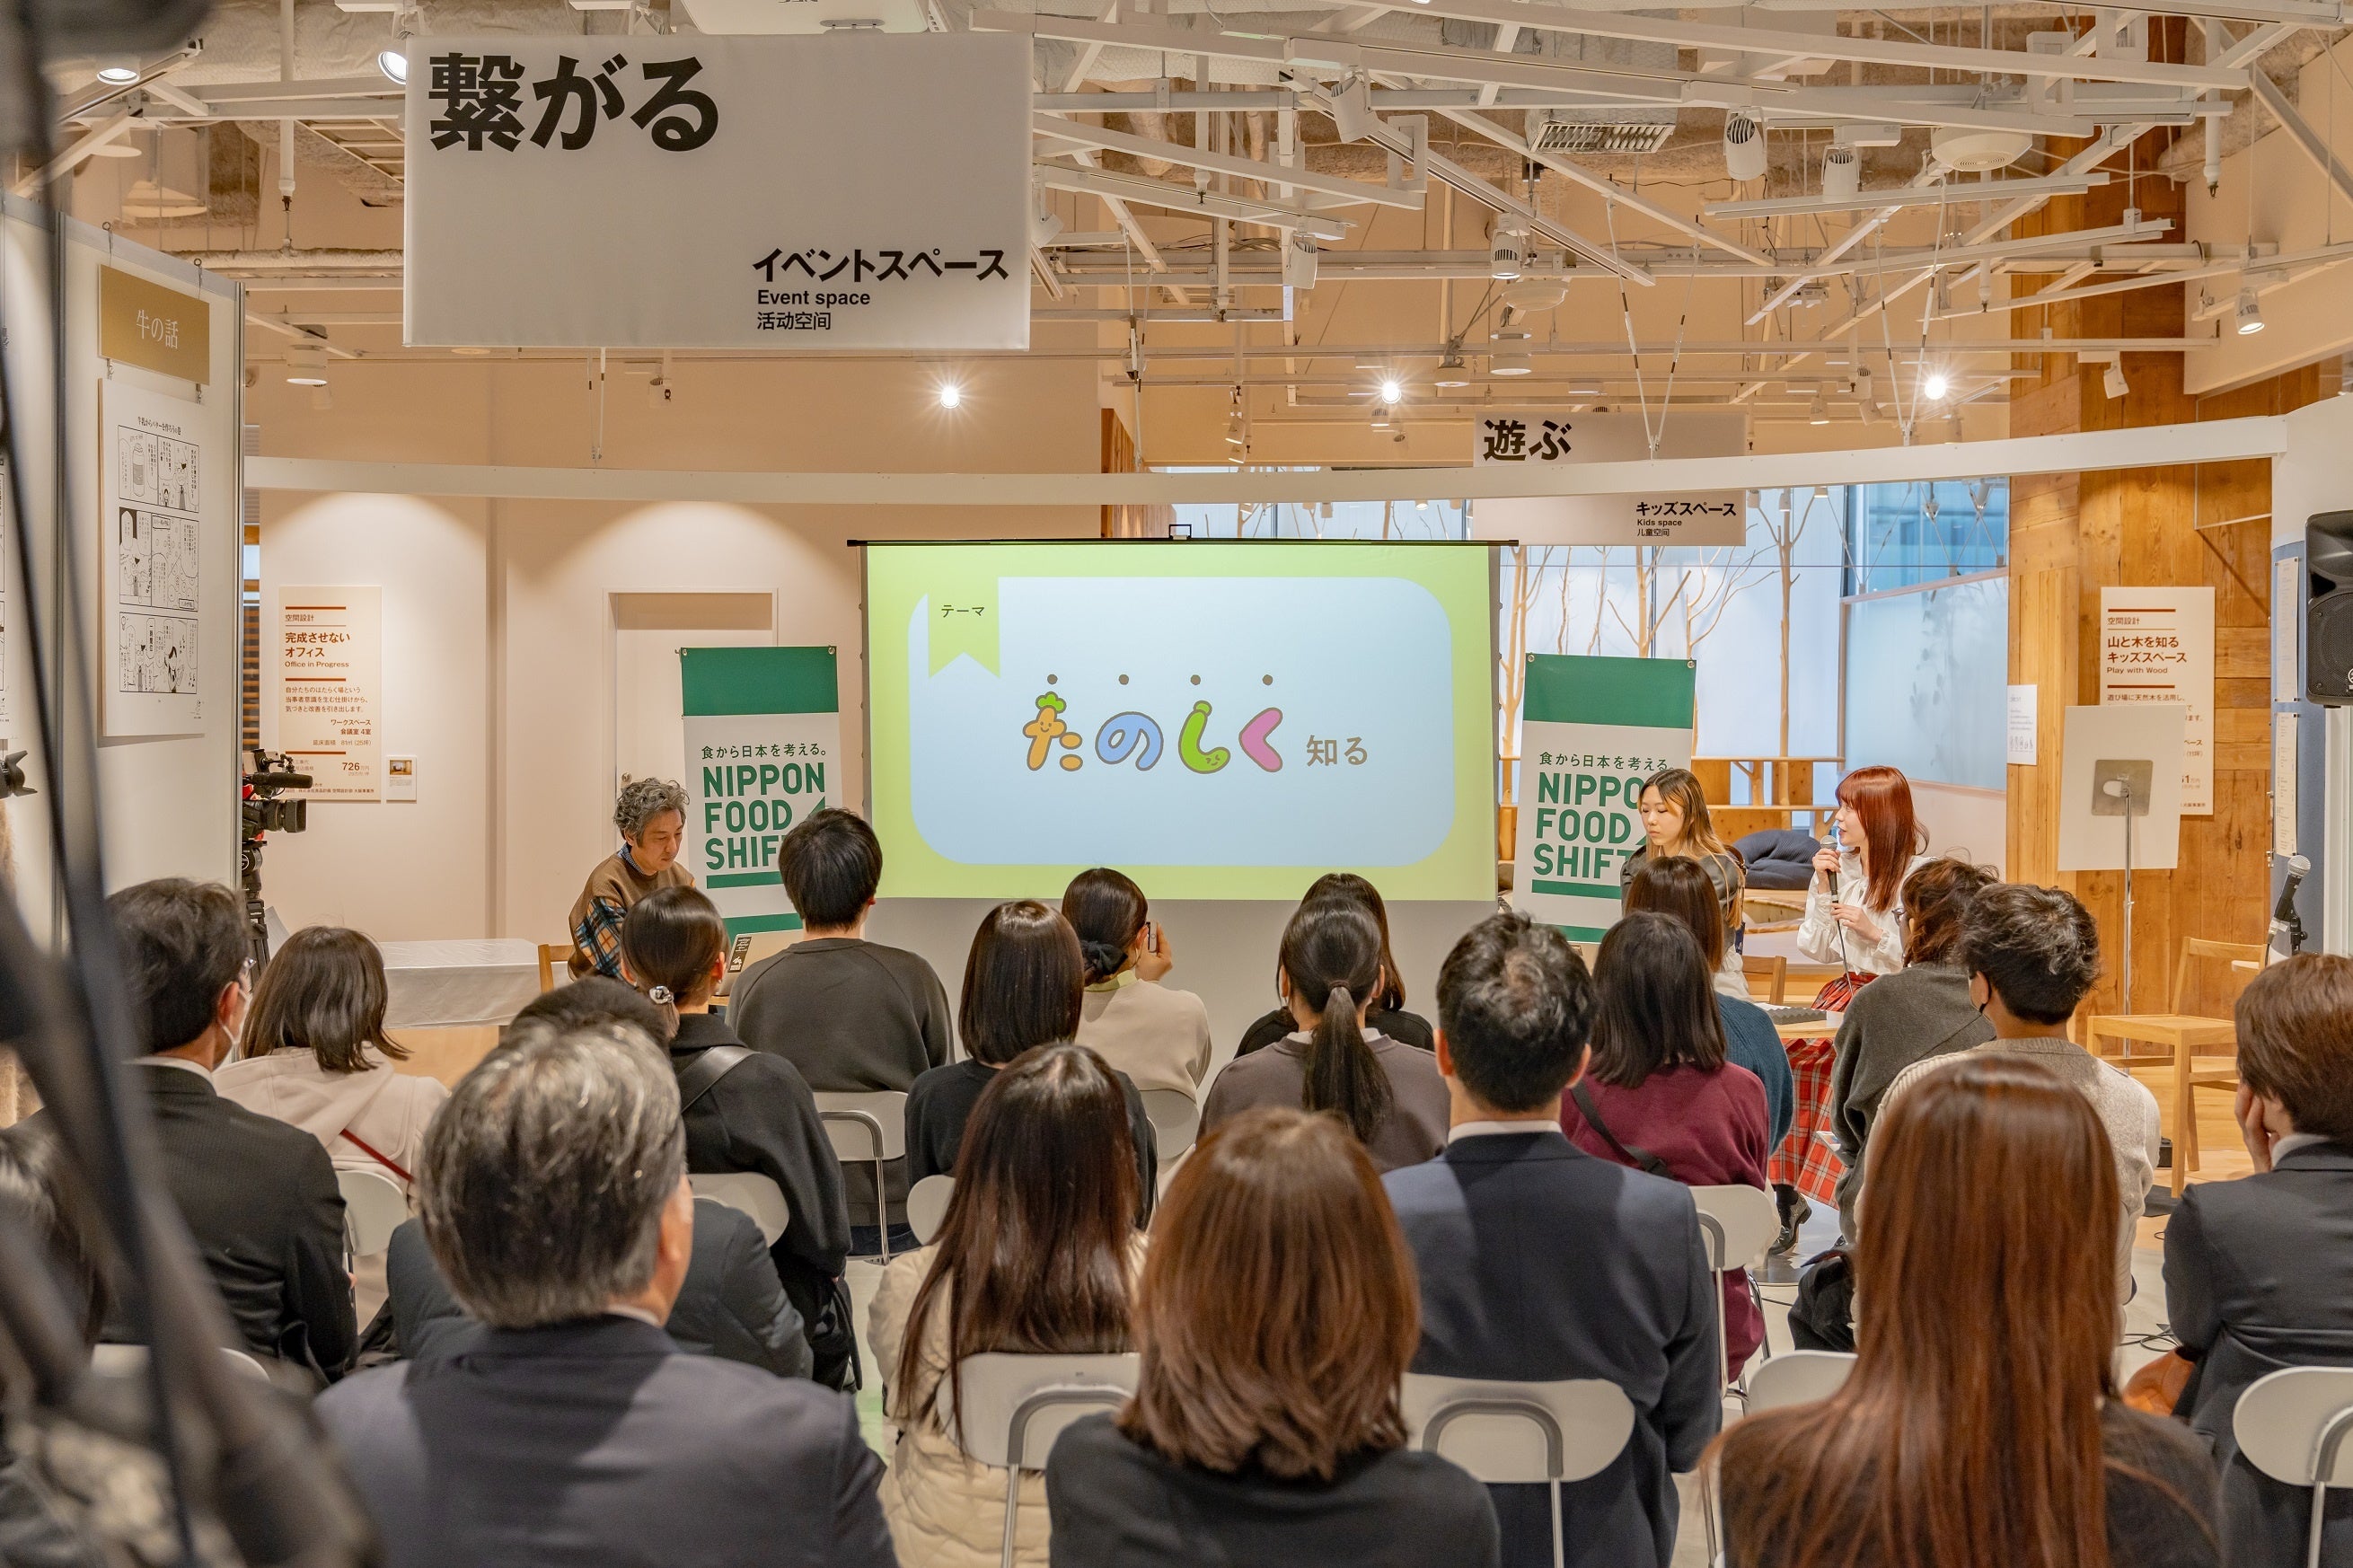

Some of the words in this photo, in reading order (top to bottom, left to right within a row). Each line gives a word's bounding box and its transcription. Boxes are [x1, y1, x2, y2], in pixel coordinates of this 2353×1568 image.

[428, 52, 719, 153] 繋がる
[752, 247, 1010, 283] イベントスペース
[757, 288, 809, 306] Event
[815, 291, 871, 311] space
[136, 308, 179, 350] 牛の話
[756, 311, 832, 331] 活动空间
[1483, 418, 1573, 462] 遊ぶ
[1635, 500, 1737, 517] キッズスペース
[1637, 518, 1656, 526] Kids
[1658, 519, 1682, 528] space
[1636, 528, 1670, 537] 儿童空间
[285, 613, 315, 622] 空間設計
[939, 603, 986, 618] テーマ
[2106, 616, 2140, 626] 空間設計
[285, 631, 351, 644] 完成させない
[2107, 635, 2180, 648] 山と木を知る
[285, 647, 325, 658] オフィス
[2107, 651, 2188, 664] キッズスペース
[316, 660, 349, 668] Progress
[2106, 666, 2125, 674] Play
[1022, 691, 1284, 774] たのしく
[1305, 733, 1370, 768] 知る
[701, 744, 826, 761] 食から日本を考える。
[703, 762, 825, 798] NIPPON
[1538, 772, 1645, 810] NIPPO
[705, 799, 793, 834] FOOD
[1536, 808, 1632, 845] FOOD
[705, 834, 787, 871] SHIF
